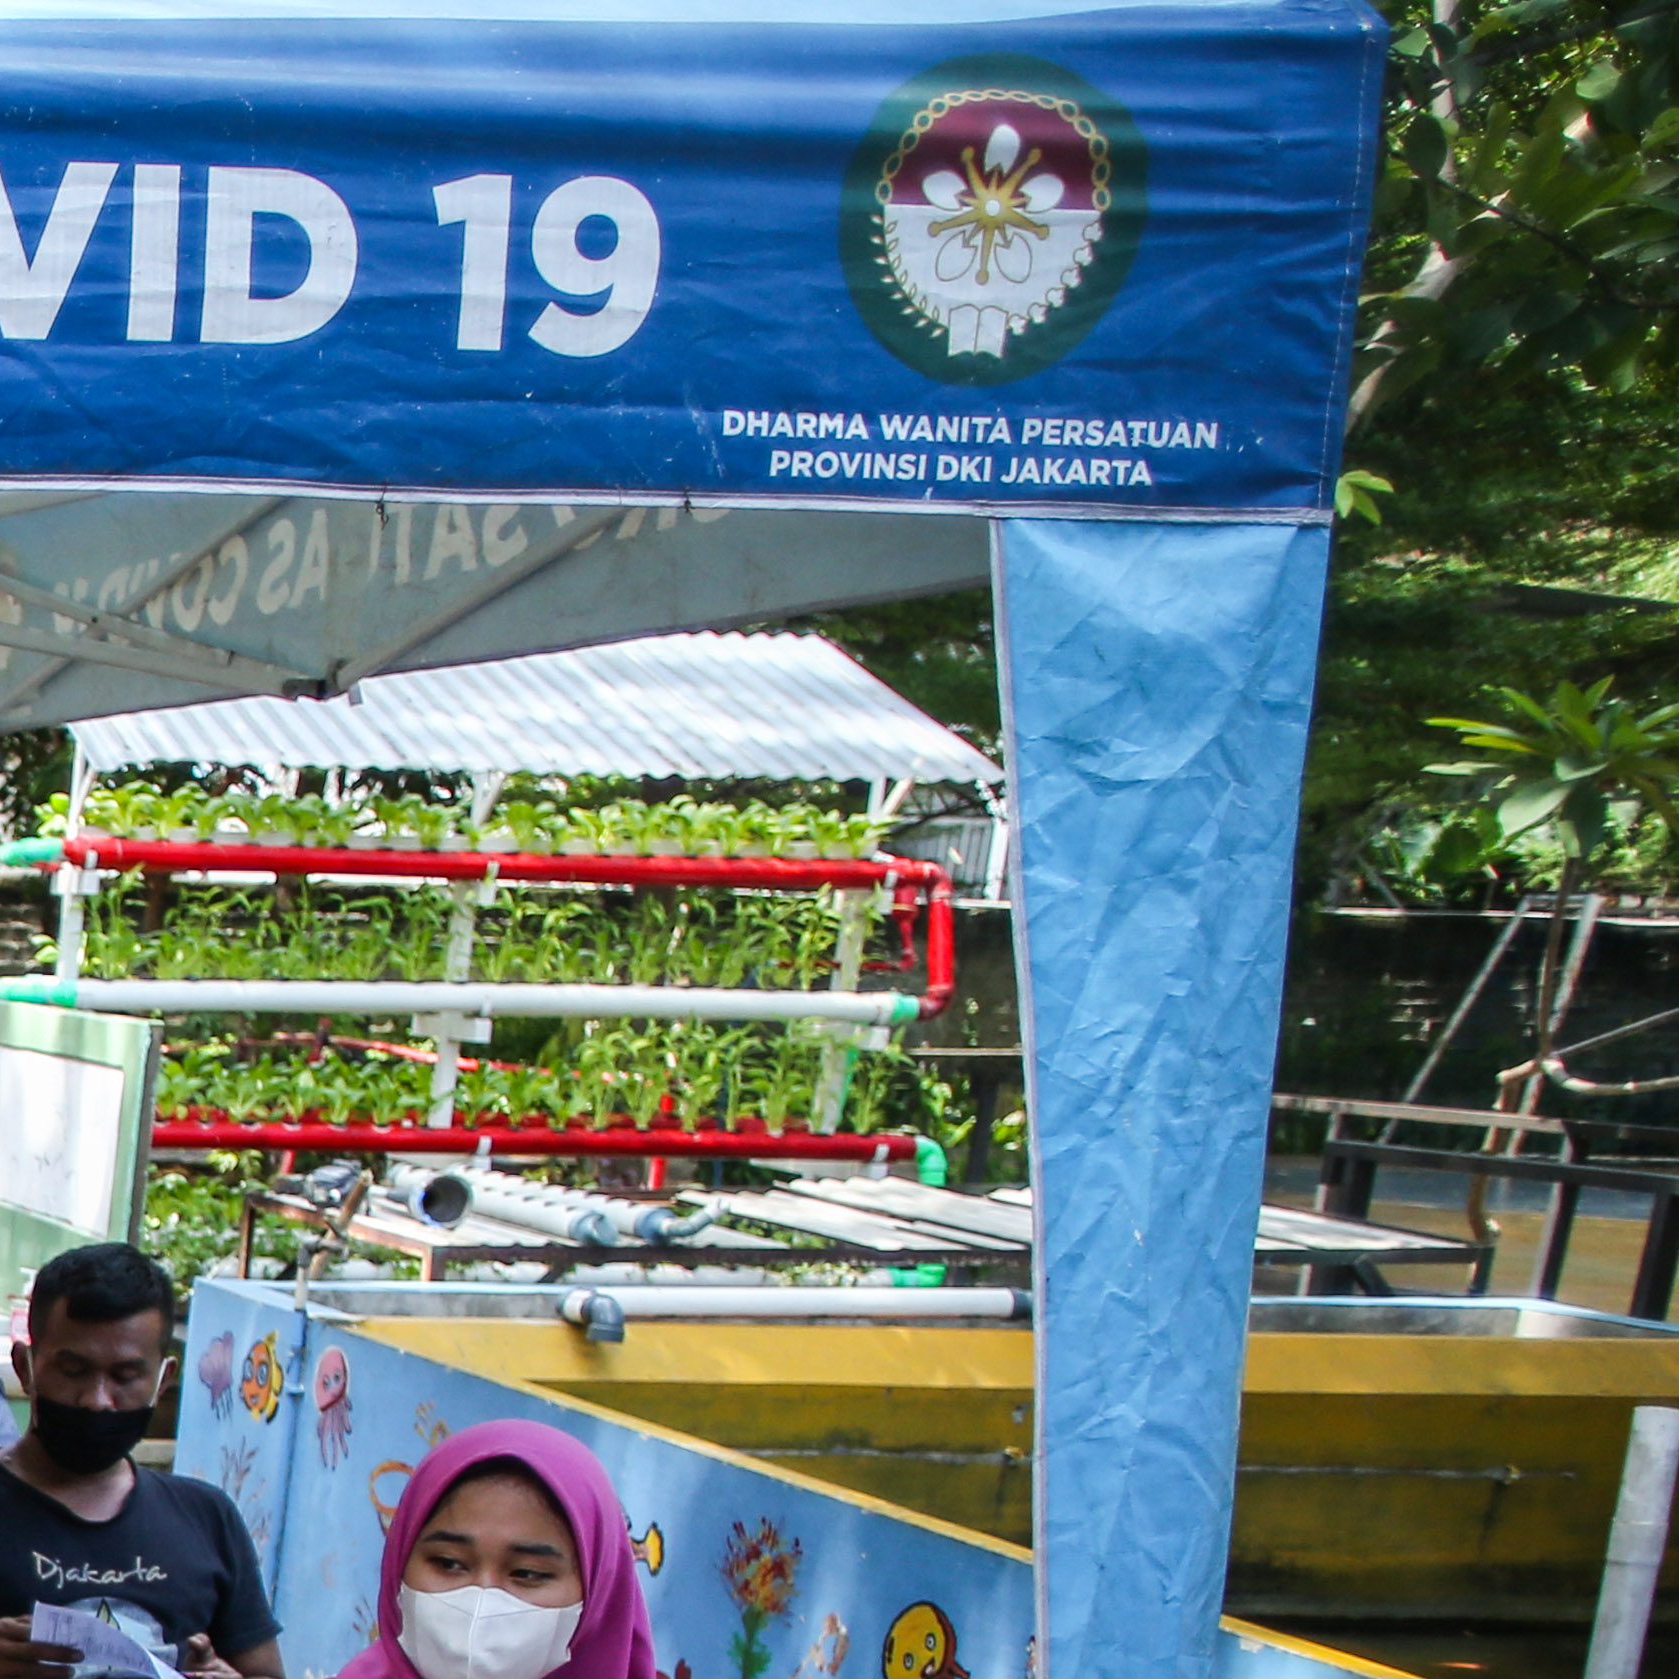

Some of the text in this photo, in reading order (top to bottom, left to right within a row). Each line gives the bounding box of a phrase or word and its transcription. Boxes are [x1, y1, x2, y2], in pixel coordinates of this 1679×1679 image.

[433, 172, 663, 360] 19
[722, 410, 1219, 449] DHARMA WANITA PERSATUAN
[769, 450, 1153, 487] PROVINSI DKI JAKARTA
[32, 1551, 168, 1589] Djakarta
